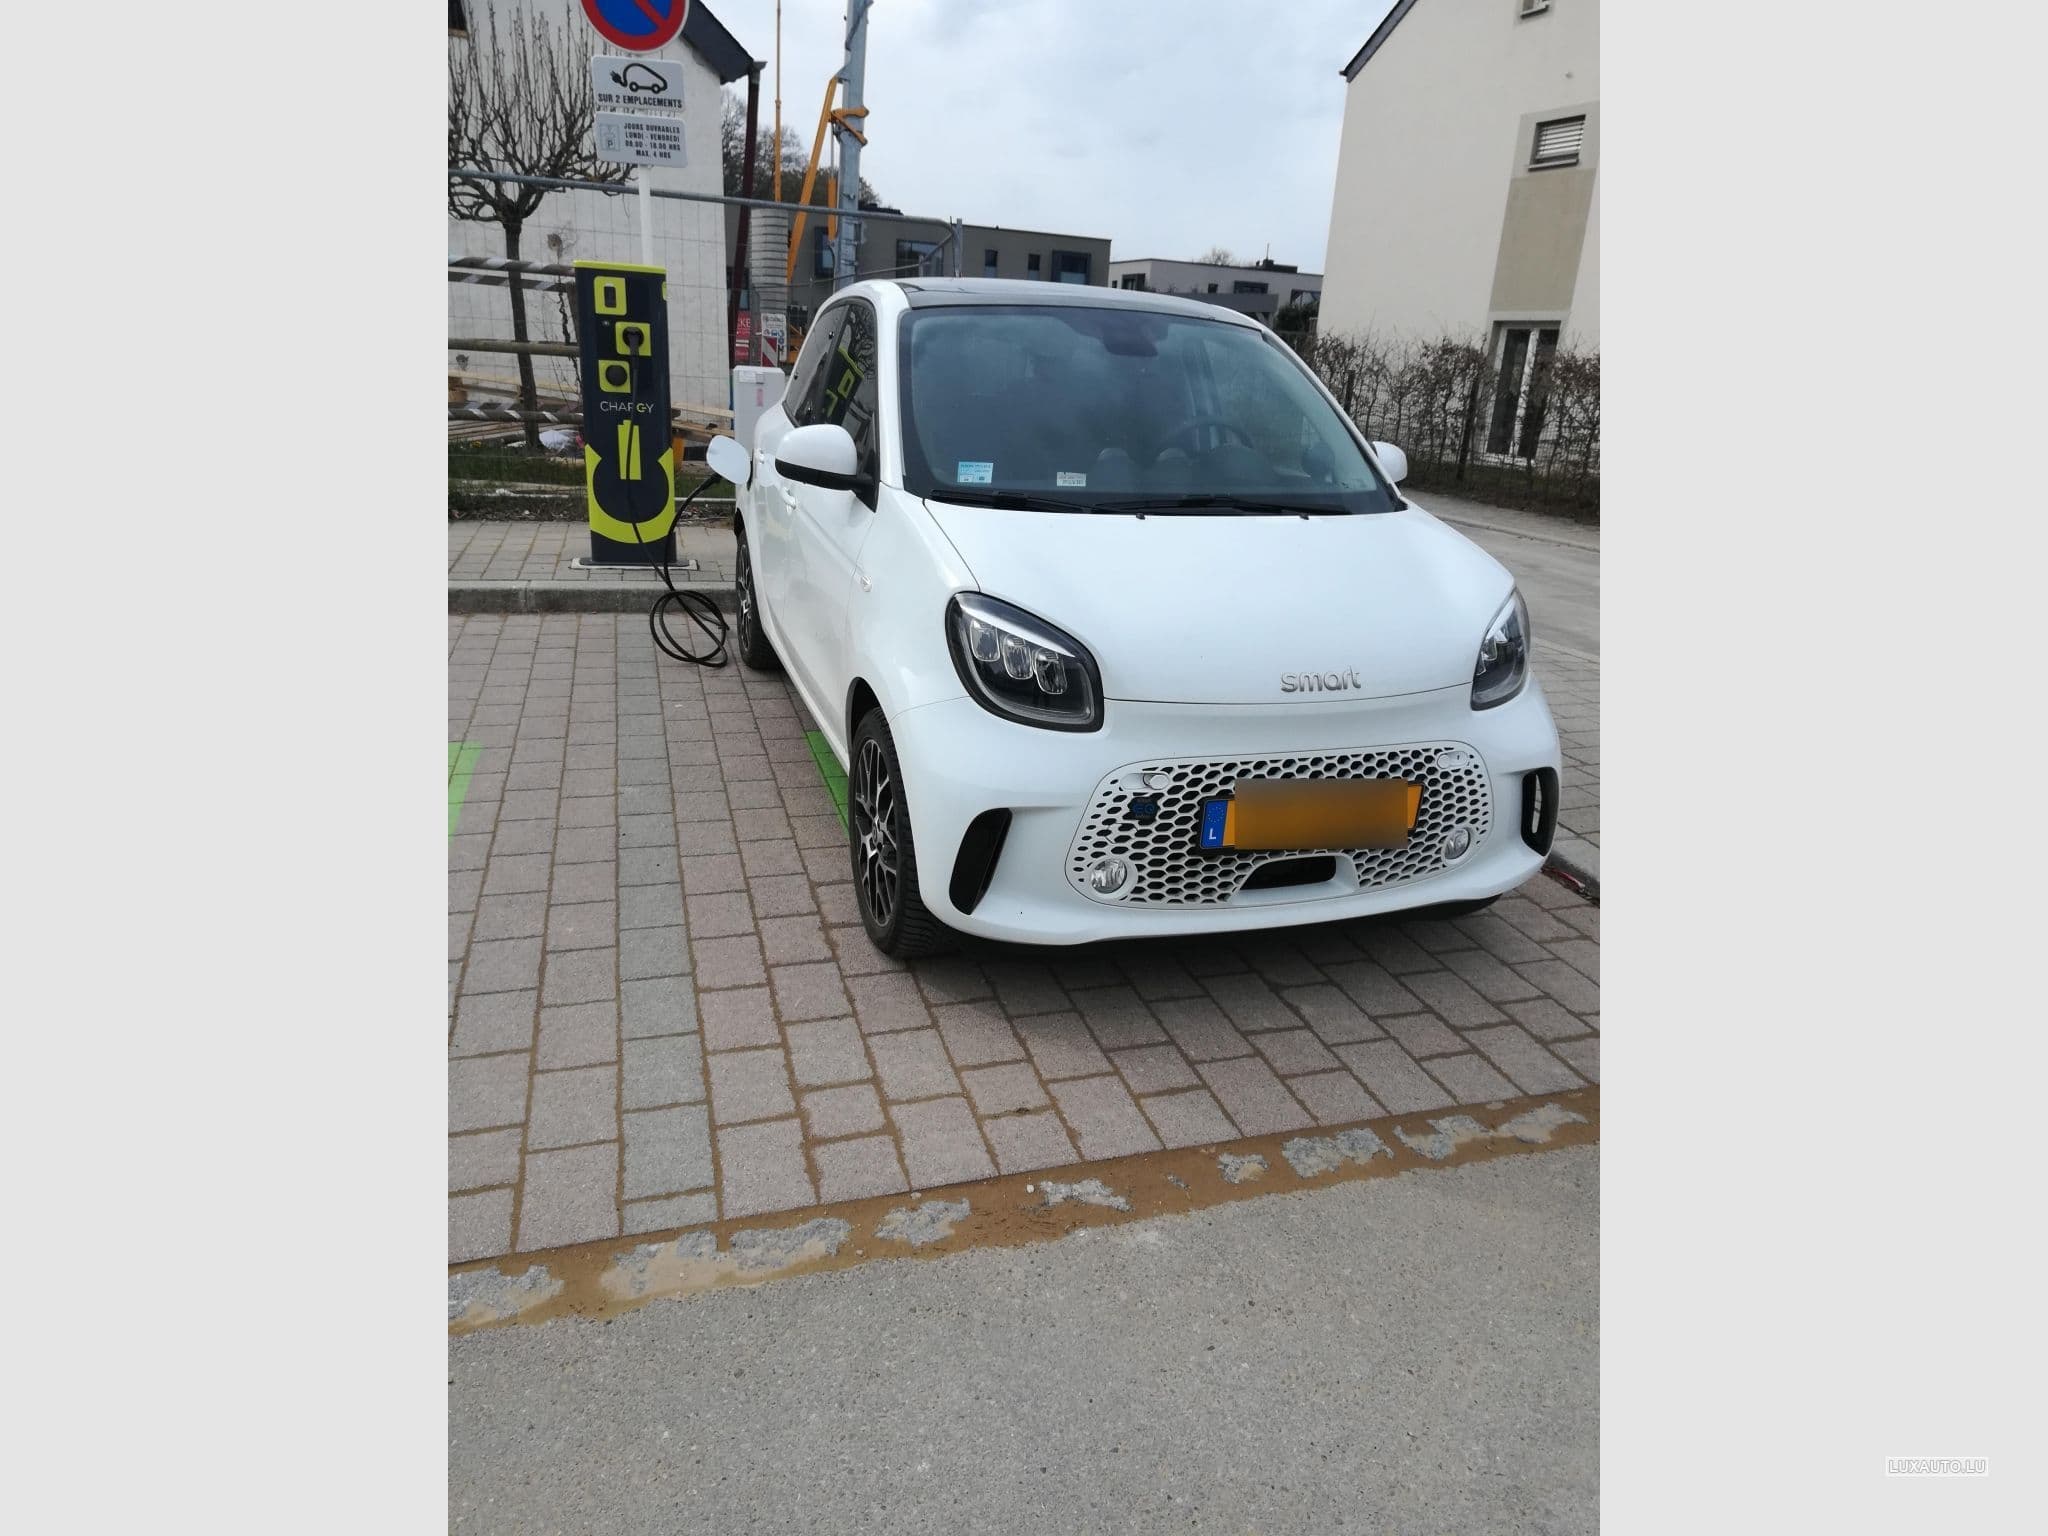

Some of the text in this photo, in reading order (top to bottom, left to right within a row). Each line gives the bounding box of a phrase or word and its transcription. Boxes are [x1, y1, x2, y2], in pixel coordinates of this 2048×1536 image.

[597, 93, 682, 108] SUR 2 EMPLACEMENTS
[623, 122, 681, 134] JOURS OUVRABLES
[625, 131, 644, 140] LUNDI
[650, 133, 680, 143] VENDREDI
[607, 140, 614, 148] P
[1280, 665, 1362, 693] smart
[1208, 827, 1217, 840] L
